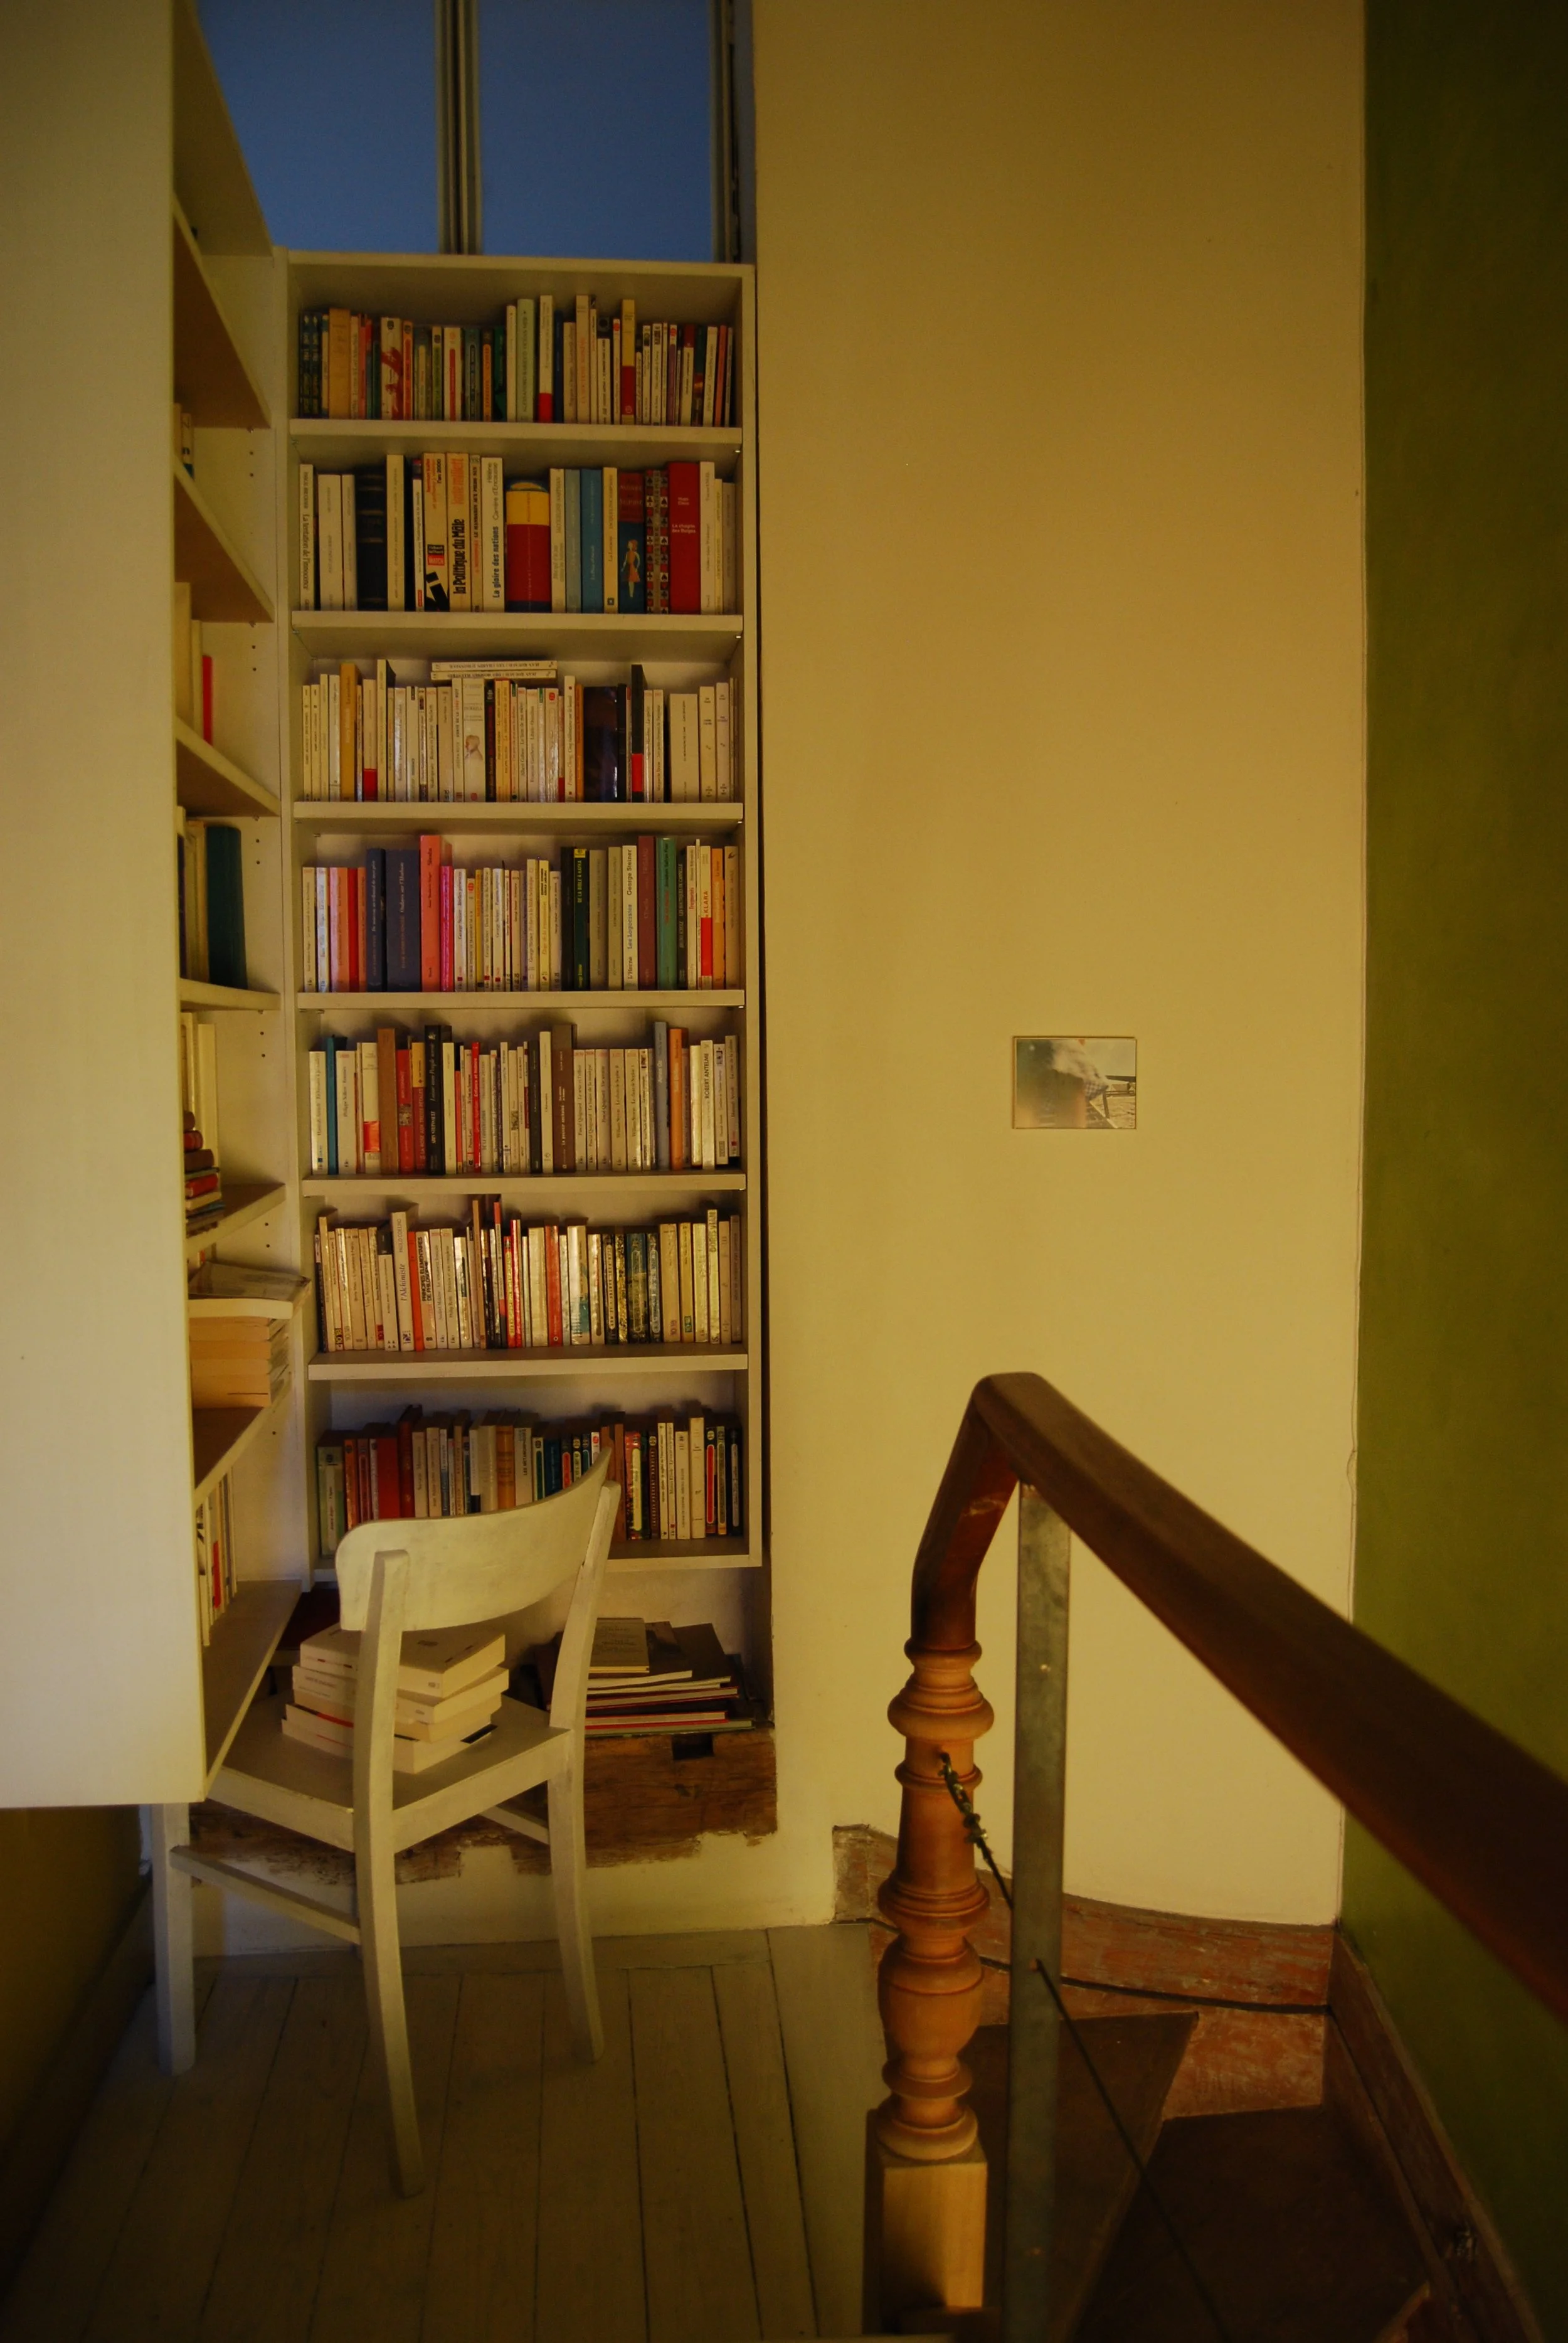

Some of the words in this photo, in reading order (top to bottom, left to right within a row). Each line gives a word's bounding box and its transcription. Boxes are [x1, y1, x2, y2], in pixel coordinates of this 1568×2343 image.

[452, 519, 464, 538] Mâle
[452, 539, 465, 549] du
[453, 550, 467, 585] Politique
[492, 568, 501, 588] gloire
[400, 1263, 408, 1300] l'Alchimiste
